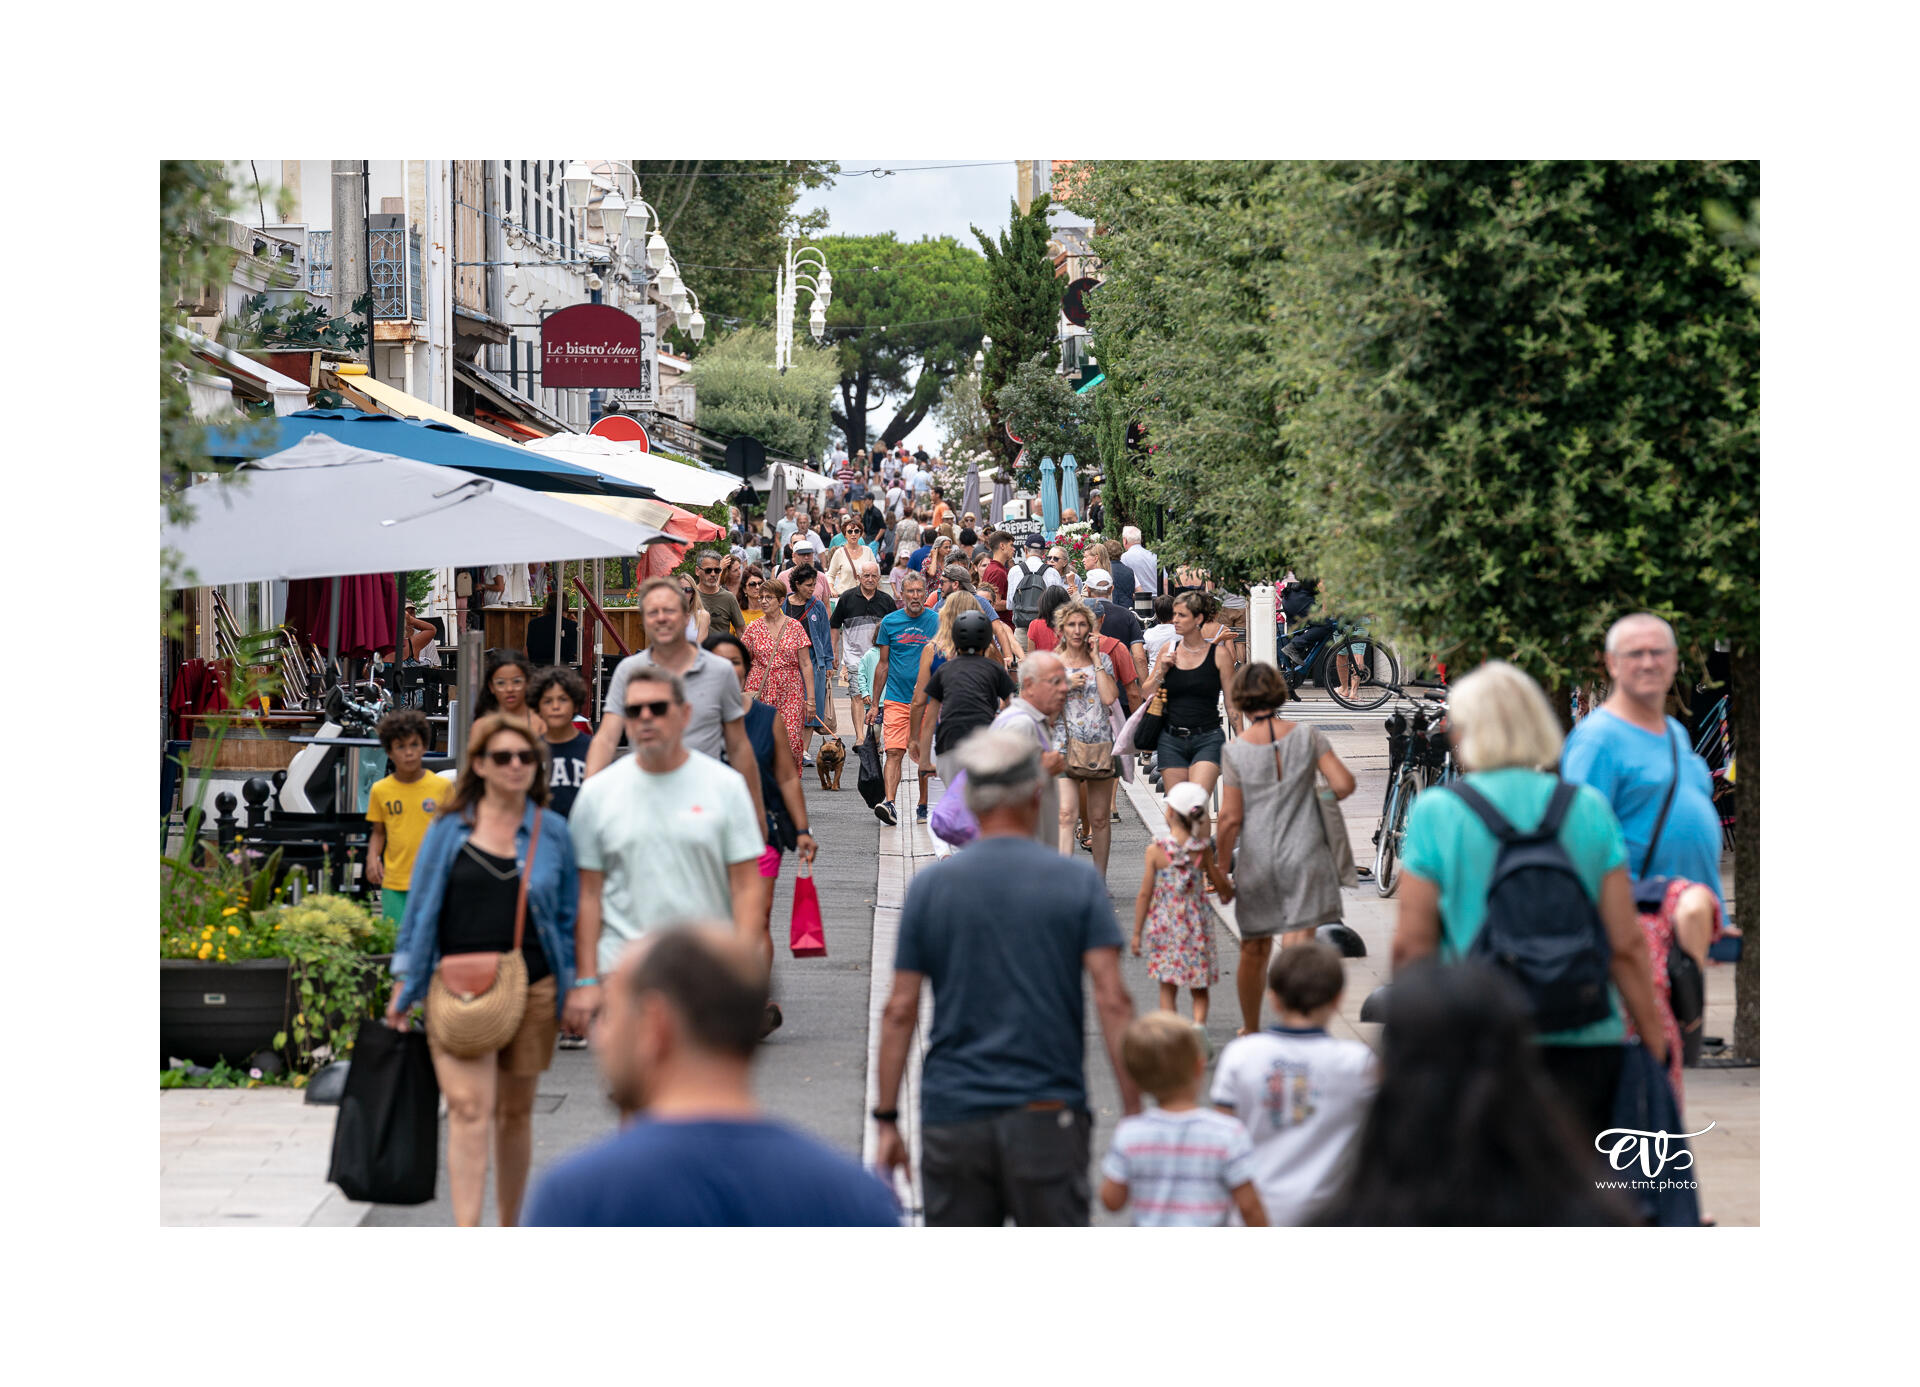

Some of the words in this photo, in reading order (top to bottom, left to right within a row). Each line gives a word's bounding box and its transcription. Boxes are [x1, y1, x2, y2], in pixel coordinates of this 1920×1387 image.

[546, 341, 564, 355] Le
[1000, 520, 1041, 534] CRÊPERIE
[386, 800, 403, 816] 10
